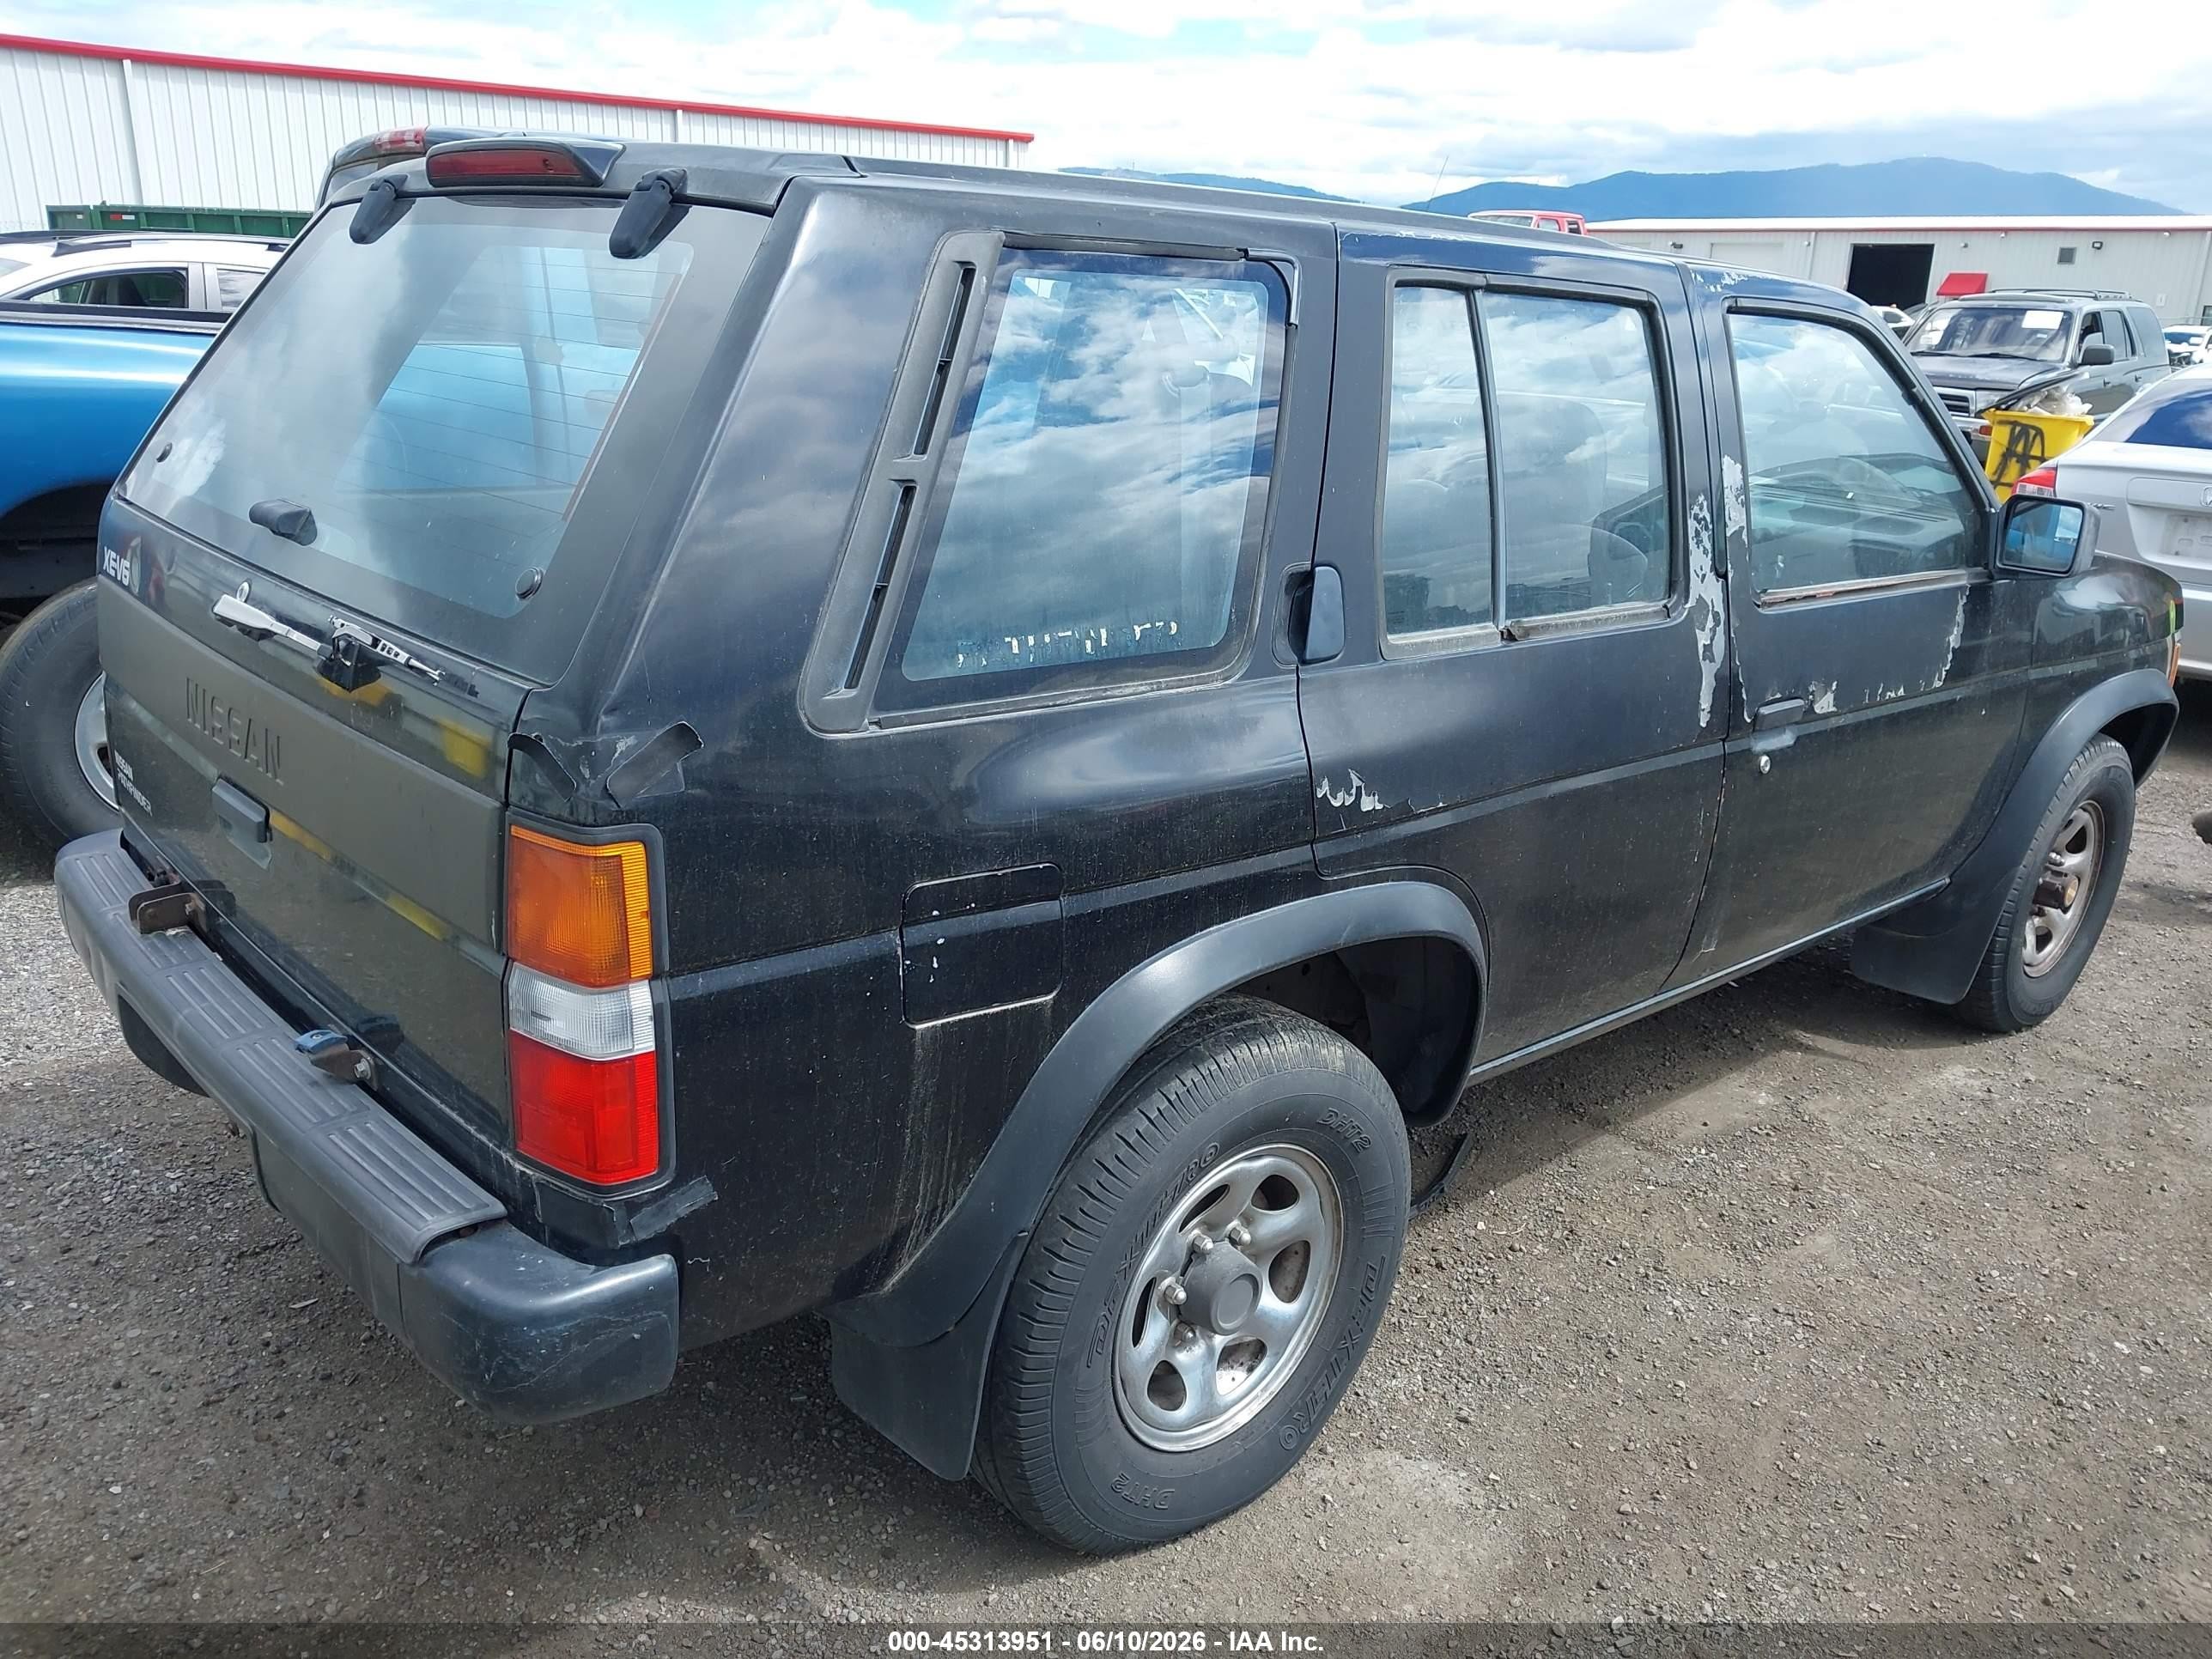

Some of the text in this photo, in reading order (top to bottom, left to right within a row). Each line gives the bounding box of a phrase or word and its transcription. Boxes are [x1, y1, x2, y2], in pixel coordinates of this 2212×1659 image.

[185, 677, 284, 786] NISSAN
[113, 750, 134, 781] NISSAN
[1316, 1107, 1372, 1152] DHT2
[1110, 1469, 1176, 1510] DHT2
